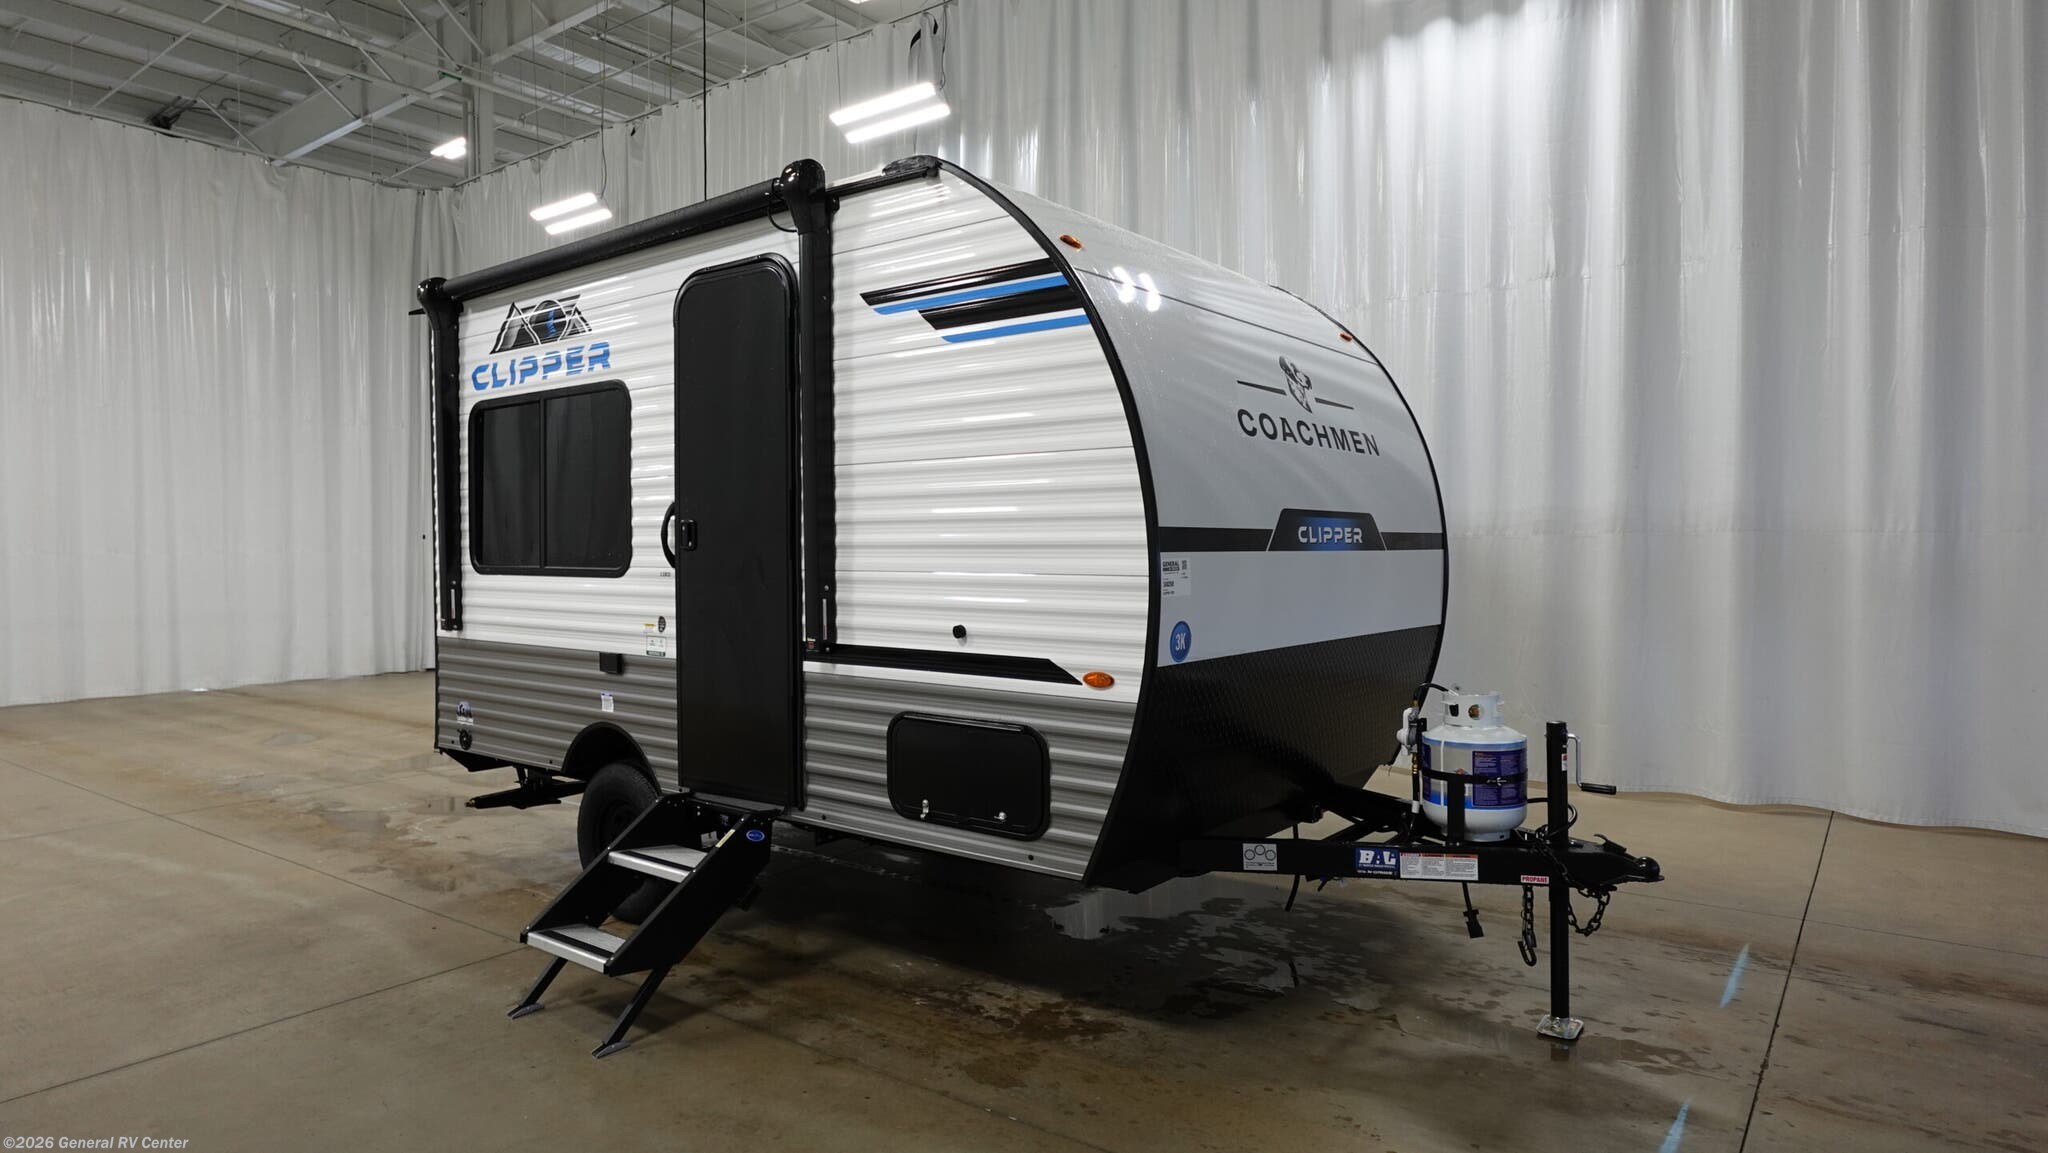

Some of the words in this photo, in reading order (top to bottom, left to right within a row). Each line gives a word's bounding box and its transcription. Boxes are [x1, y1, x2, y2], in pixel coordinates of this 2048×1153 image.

[471, 341, 612, 391] CLIPPER
[1237, 408, 1380, 457] COACHMEN
[1298, 526, 1363, 545] CLIPPER
[1175, 632, 1187, 651] 3K
[1522, 875, 1548, 884] PROPANE
